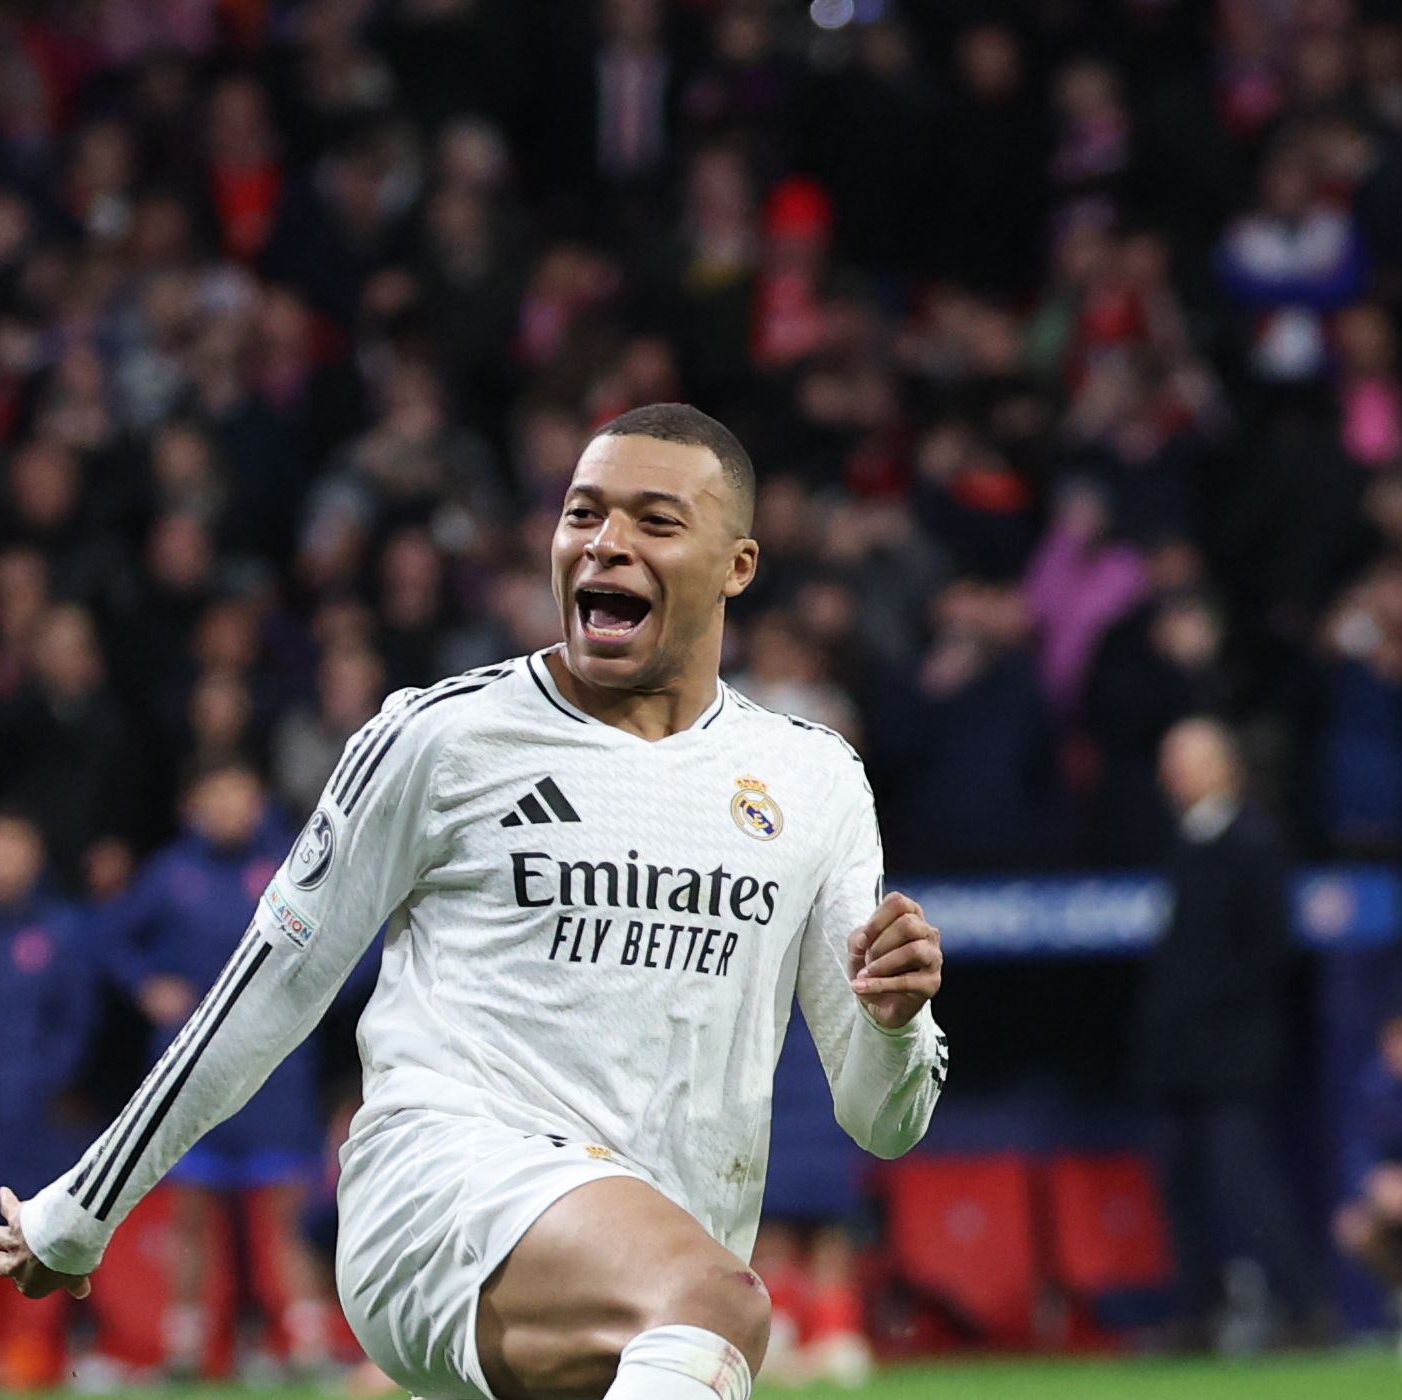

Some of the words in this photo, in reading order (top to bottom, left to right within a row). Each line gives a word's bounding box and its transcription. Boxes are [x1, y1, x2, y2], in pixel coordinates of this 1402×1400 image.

[299, 842, 315, 865] 15
[509, 849, 779, 926] Emirates
[548, 916, 612, 963] FLY
[620, 920, 739, 976] BETTER
